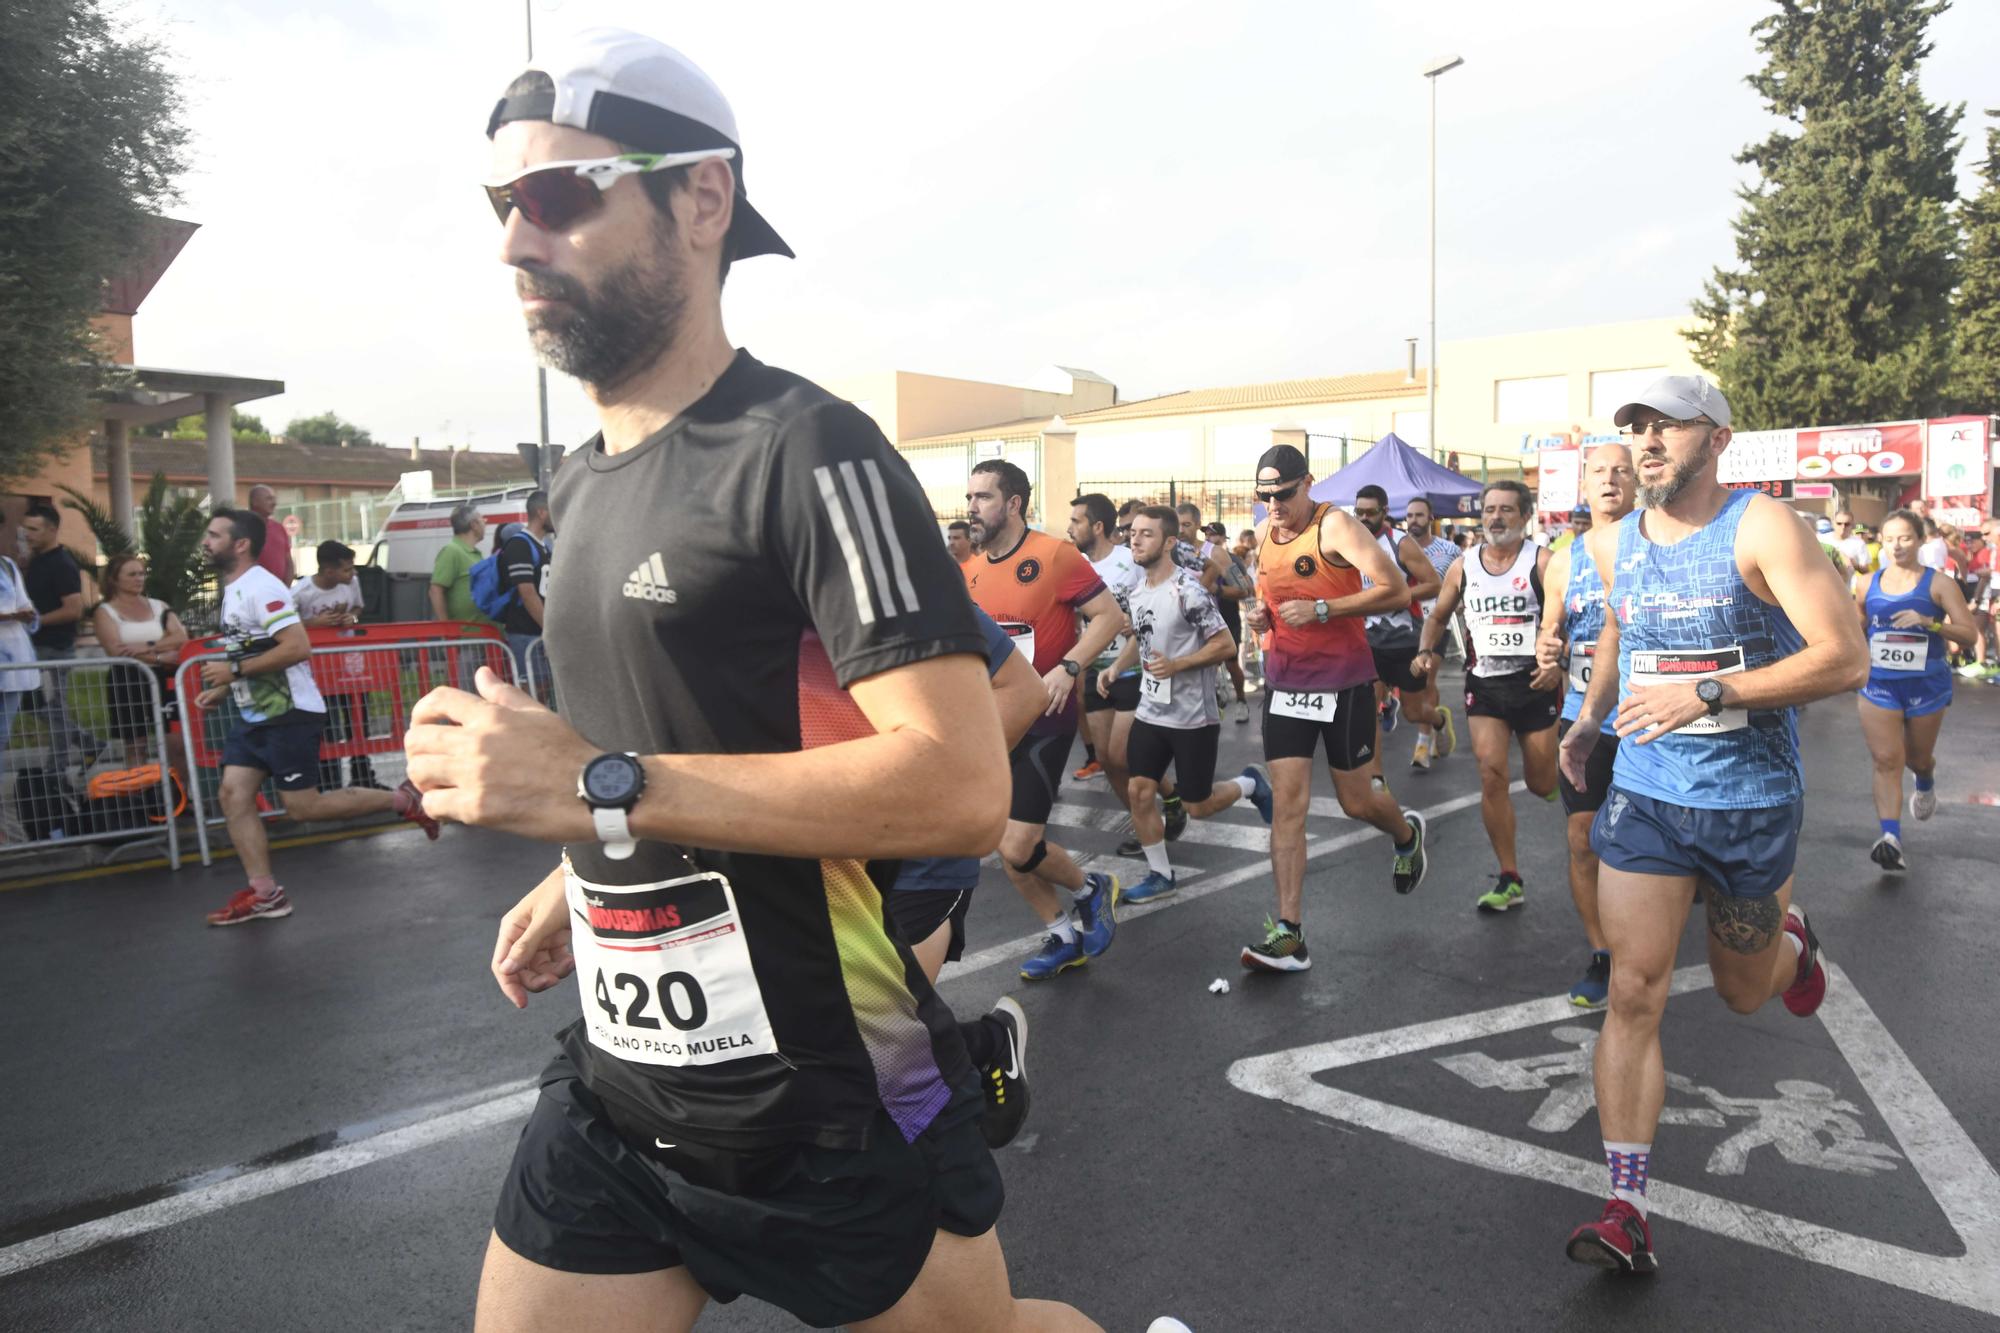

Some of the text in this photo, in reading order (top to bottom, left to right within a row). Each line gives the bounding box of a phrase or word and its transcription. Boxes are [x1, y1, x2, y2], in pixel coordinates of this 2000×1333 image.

[622, 582, 678, 604] adidas
[1488, 632, 1524, 647] 539
[1880, 648, 1915, 663] 260
[1285, 692, 1324, 711] 344
[595, 966, 708, 1032] 420
[645, 1038, 682, 1056] PACO
[686, 1033, 754, 1057] MUELA
